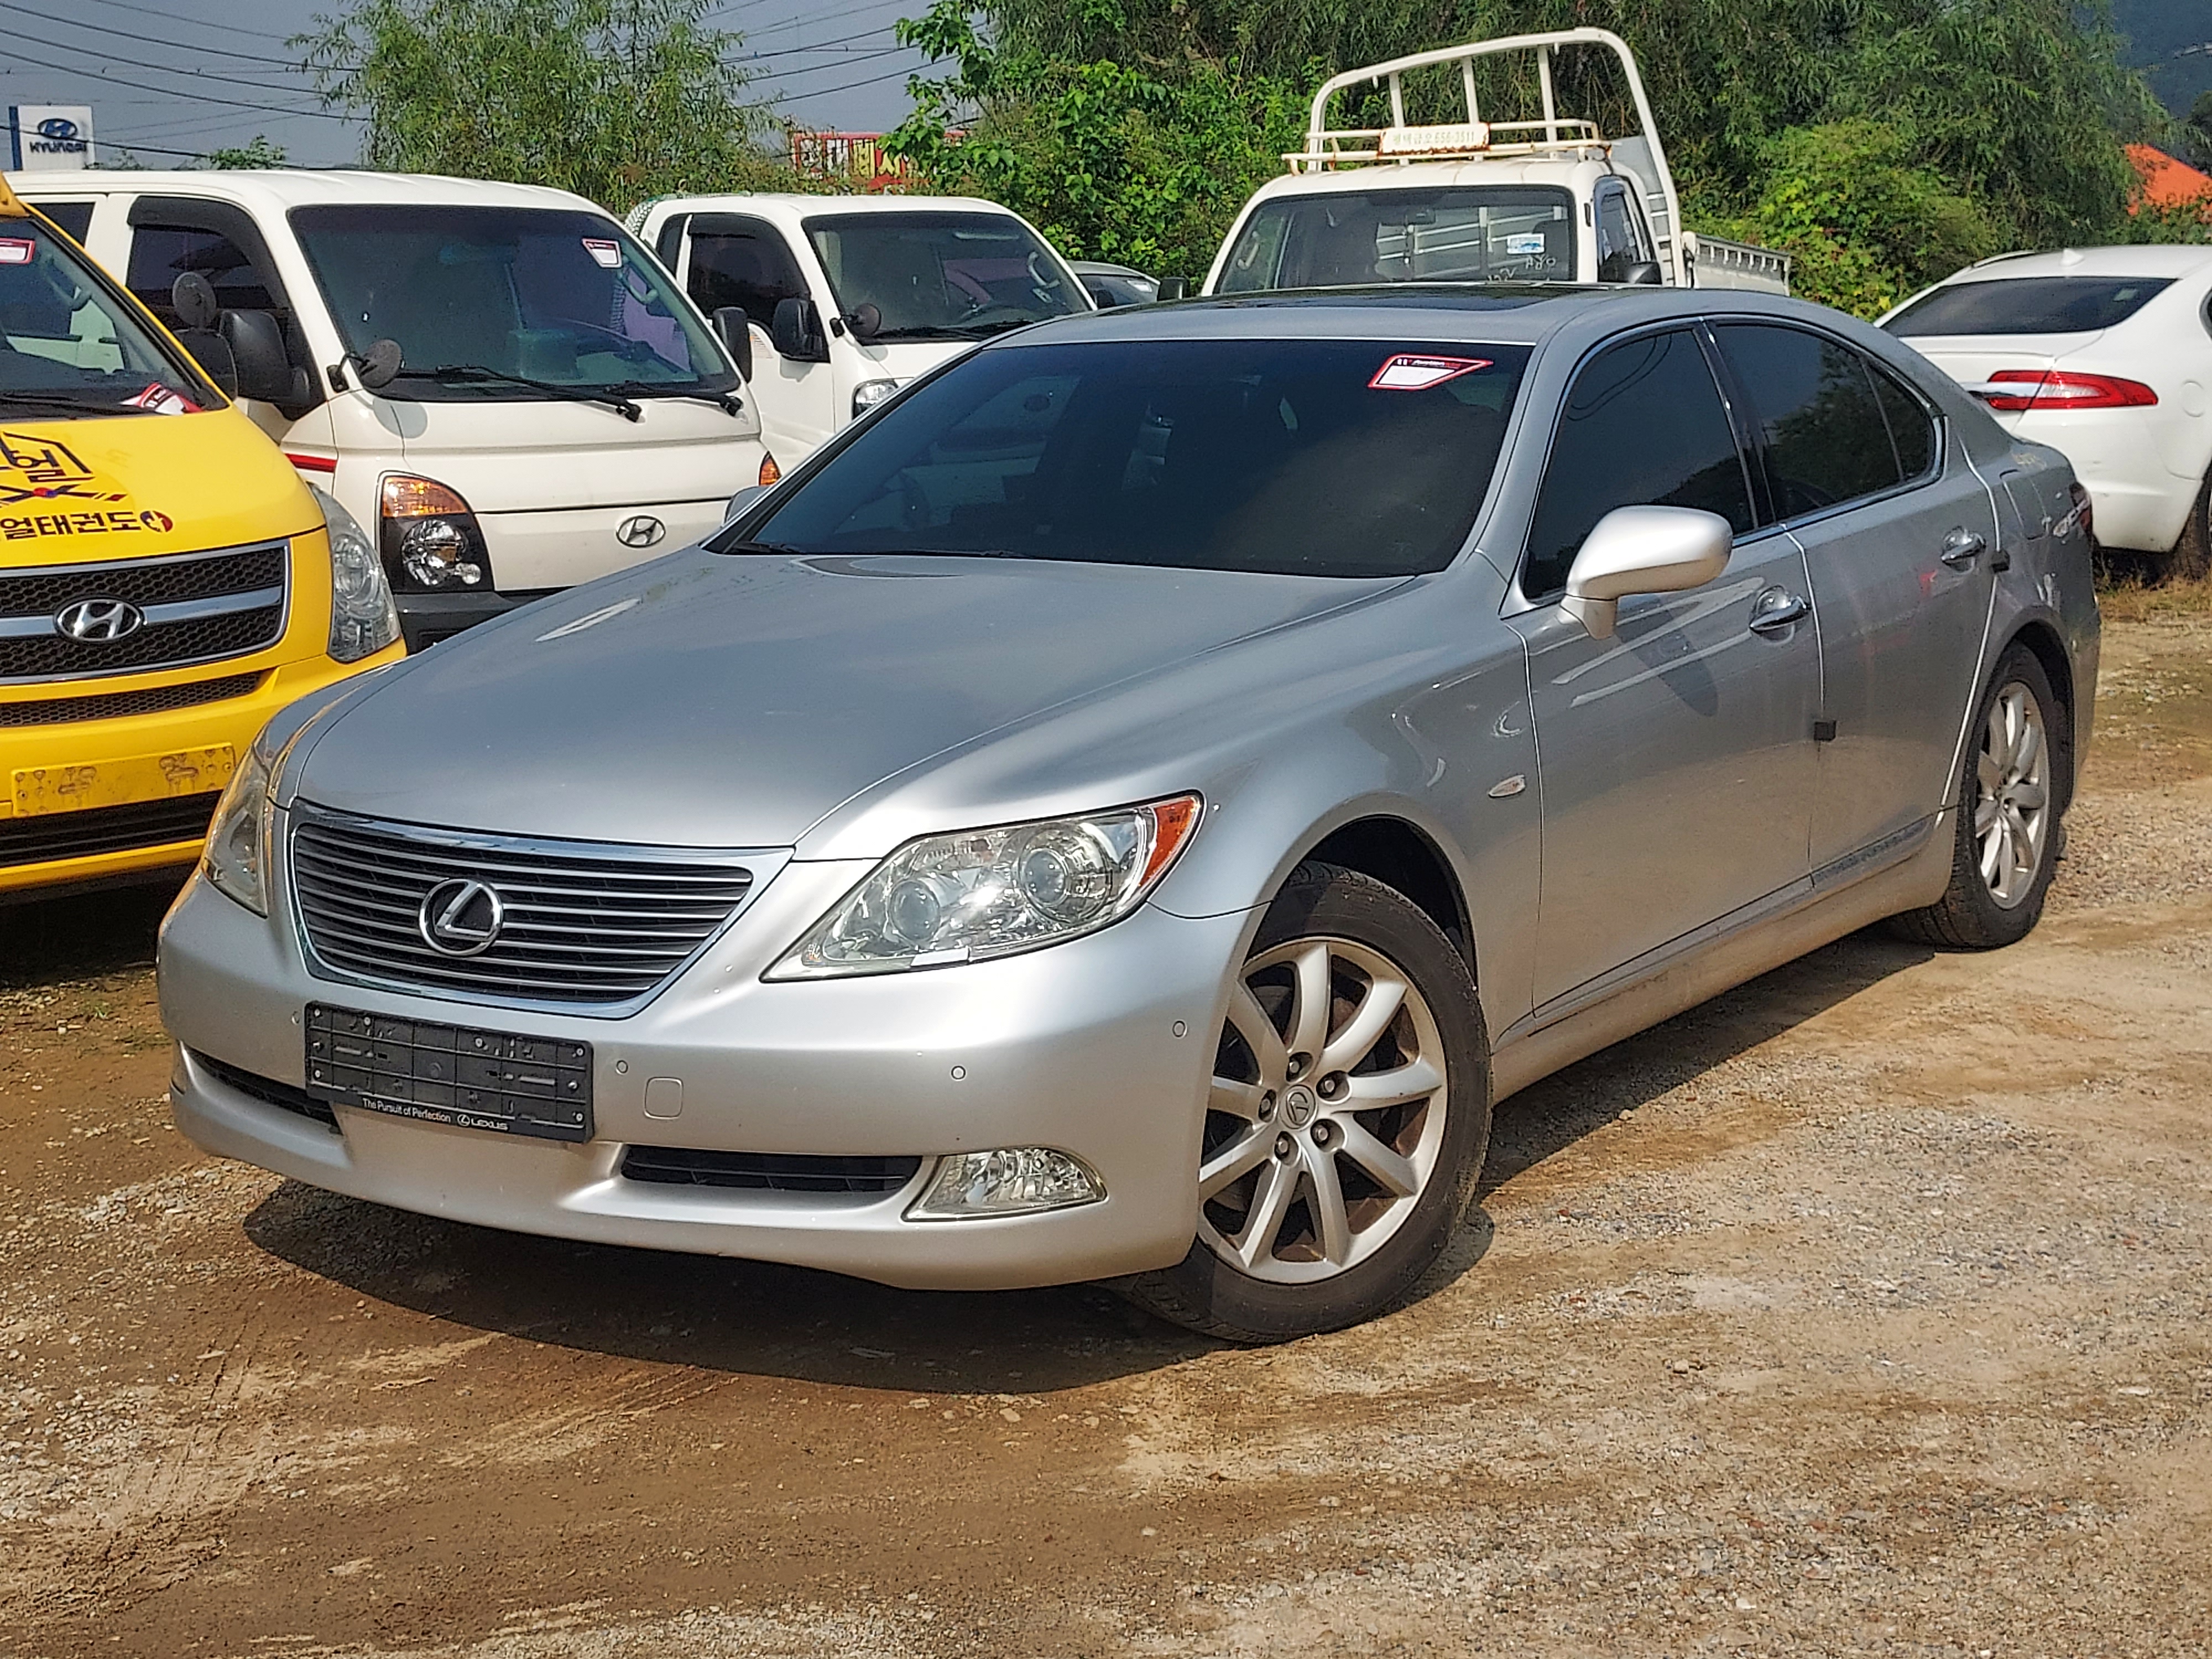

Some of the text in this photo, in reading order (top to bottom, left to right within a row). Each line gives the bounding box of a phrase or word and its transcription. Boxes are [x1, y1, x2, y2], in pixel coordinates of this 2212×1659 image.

[362, 1097, 508, 1130] The Pursuit of Perfection LEXUS
